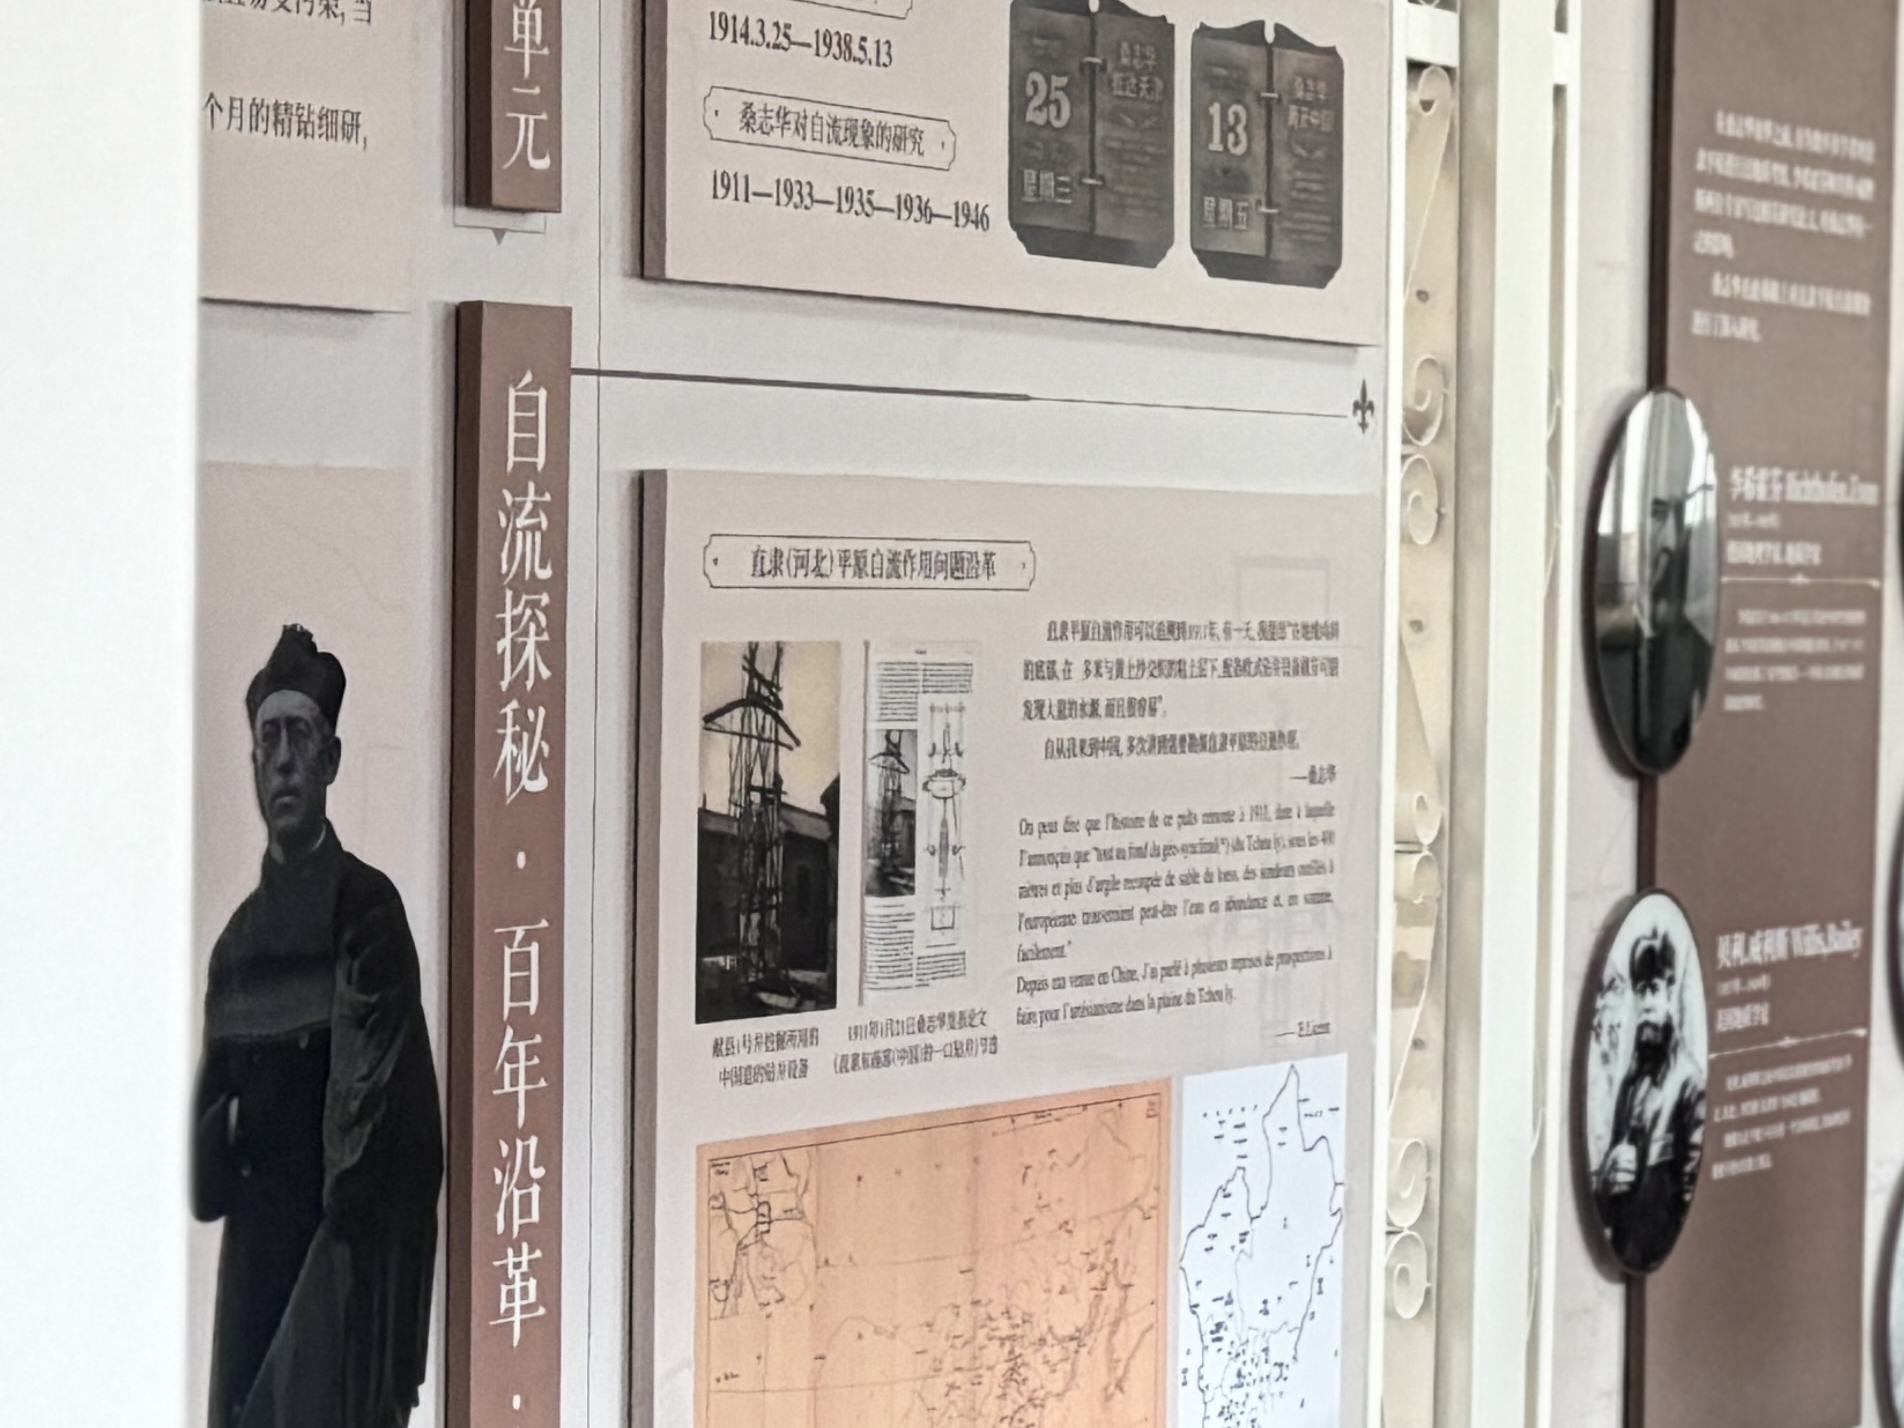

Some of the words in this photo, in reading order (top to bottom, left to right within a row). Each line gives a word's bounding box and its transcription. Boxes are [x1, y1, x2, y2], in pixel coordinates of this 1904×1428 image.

[1024, 71, 1071, 128] 25
[738, 101, 926, 158] 桑志华对自流现象的研究
[1208, 101, 1249, 156] 13
